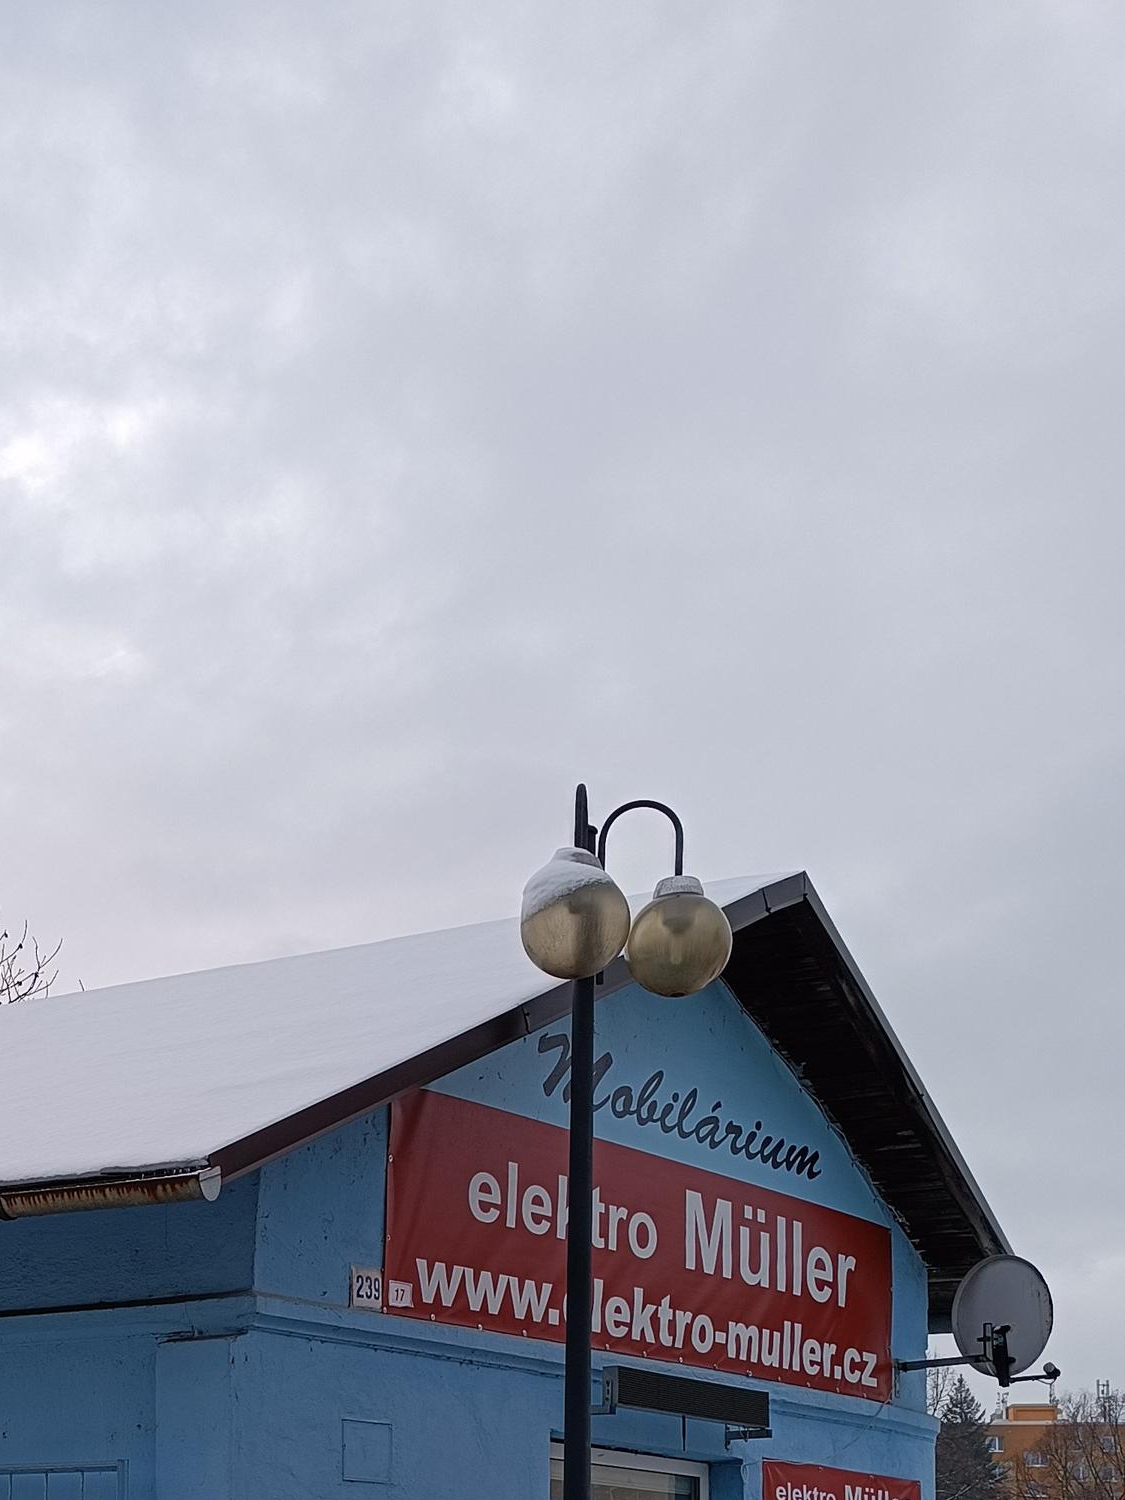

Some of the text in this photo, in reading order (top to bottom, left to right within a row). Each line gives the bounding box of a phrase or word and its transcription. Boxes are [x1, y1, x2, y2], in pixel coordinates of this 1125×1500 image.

[537, 1032, 823, 1180] Mobilárium
[356, 1274, 380, 1300] 239
[394, 1288, 406, 1302] 17
[685, 1189, 857, 1308] Müller
[416, 1258, 878, 1388] www.lektro-muller.cz
